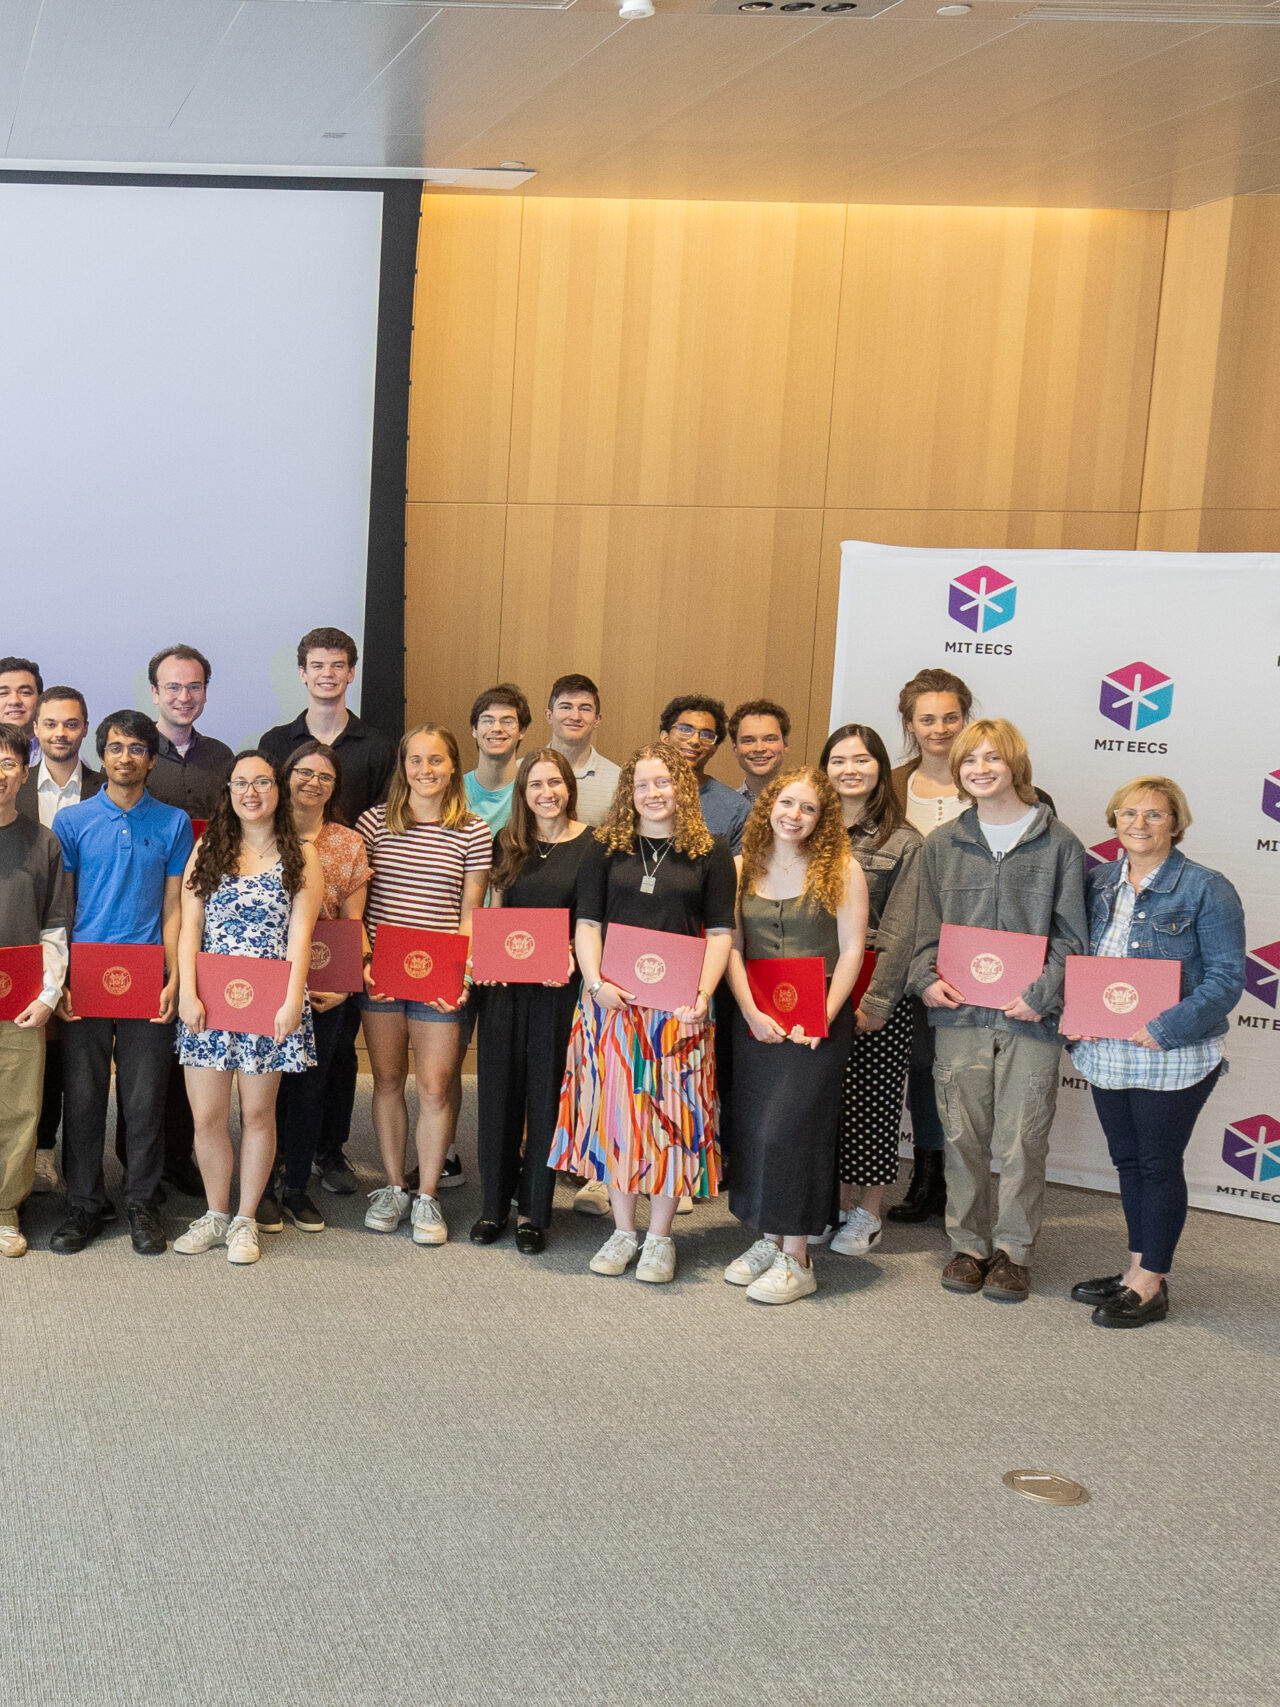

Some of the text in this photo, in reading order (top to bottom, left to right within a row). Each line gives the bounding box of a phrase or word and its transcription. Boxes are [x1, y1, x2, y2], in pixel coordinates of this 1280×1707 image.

[945, 641, 1013, 656] MIT EECS
[1094, 738, 1168, 754] MIT EECS
[1257, 838, 1280, 852] MI
[1238, 1014, 1270, 1029] MIT
[1061, 1075, 1089, 1090] MIT
[1216, 1184, 1248, 1197] MIT
